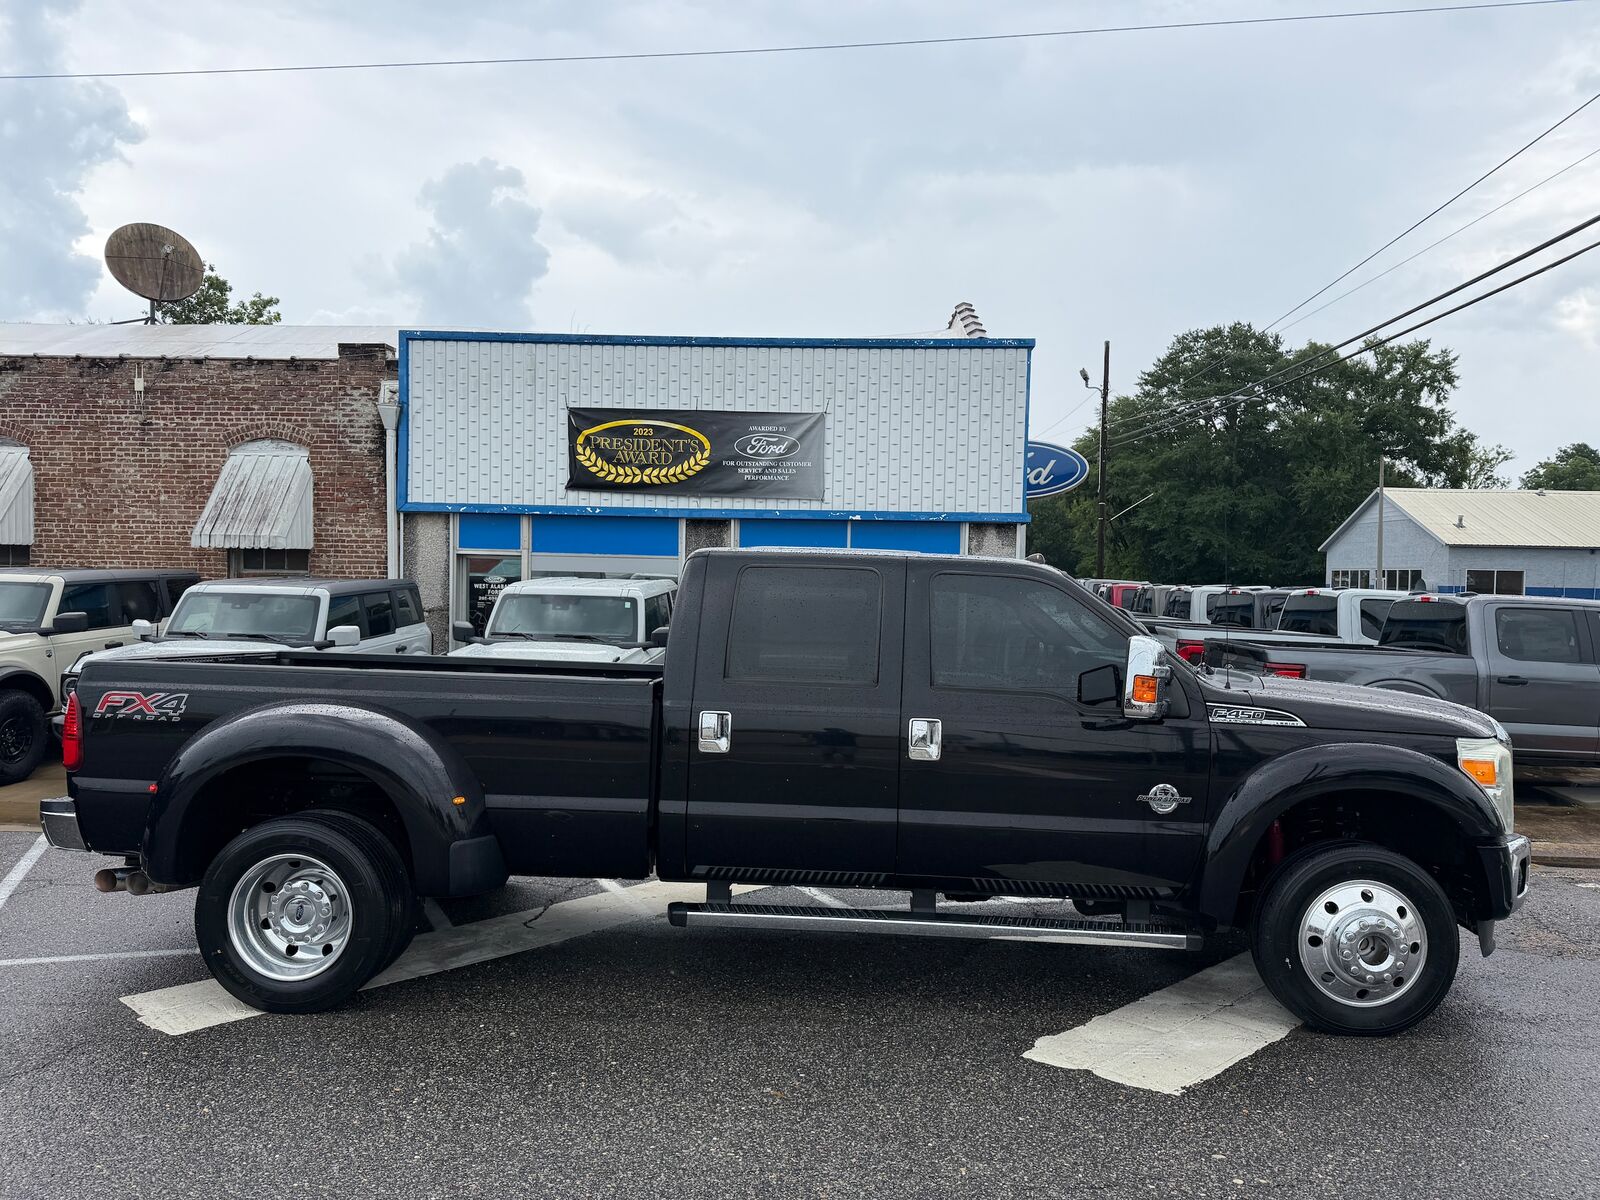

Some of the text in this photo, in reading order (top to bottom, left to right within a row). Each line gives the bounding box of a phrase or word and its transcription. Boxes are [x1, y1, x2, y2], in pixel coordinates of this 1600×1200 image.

[633, 427, 654, 436] 2023
[589, 435, 699, 453] PRESIDENT'S
[746, 436, 788, 454] Ford
[612, 451, 673, 465] AWARD
[94, 690, 190, 717] FX4
[132, 714, 181, 722] ROAD
